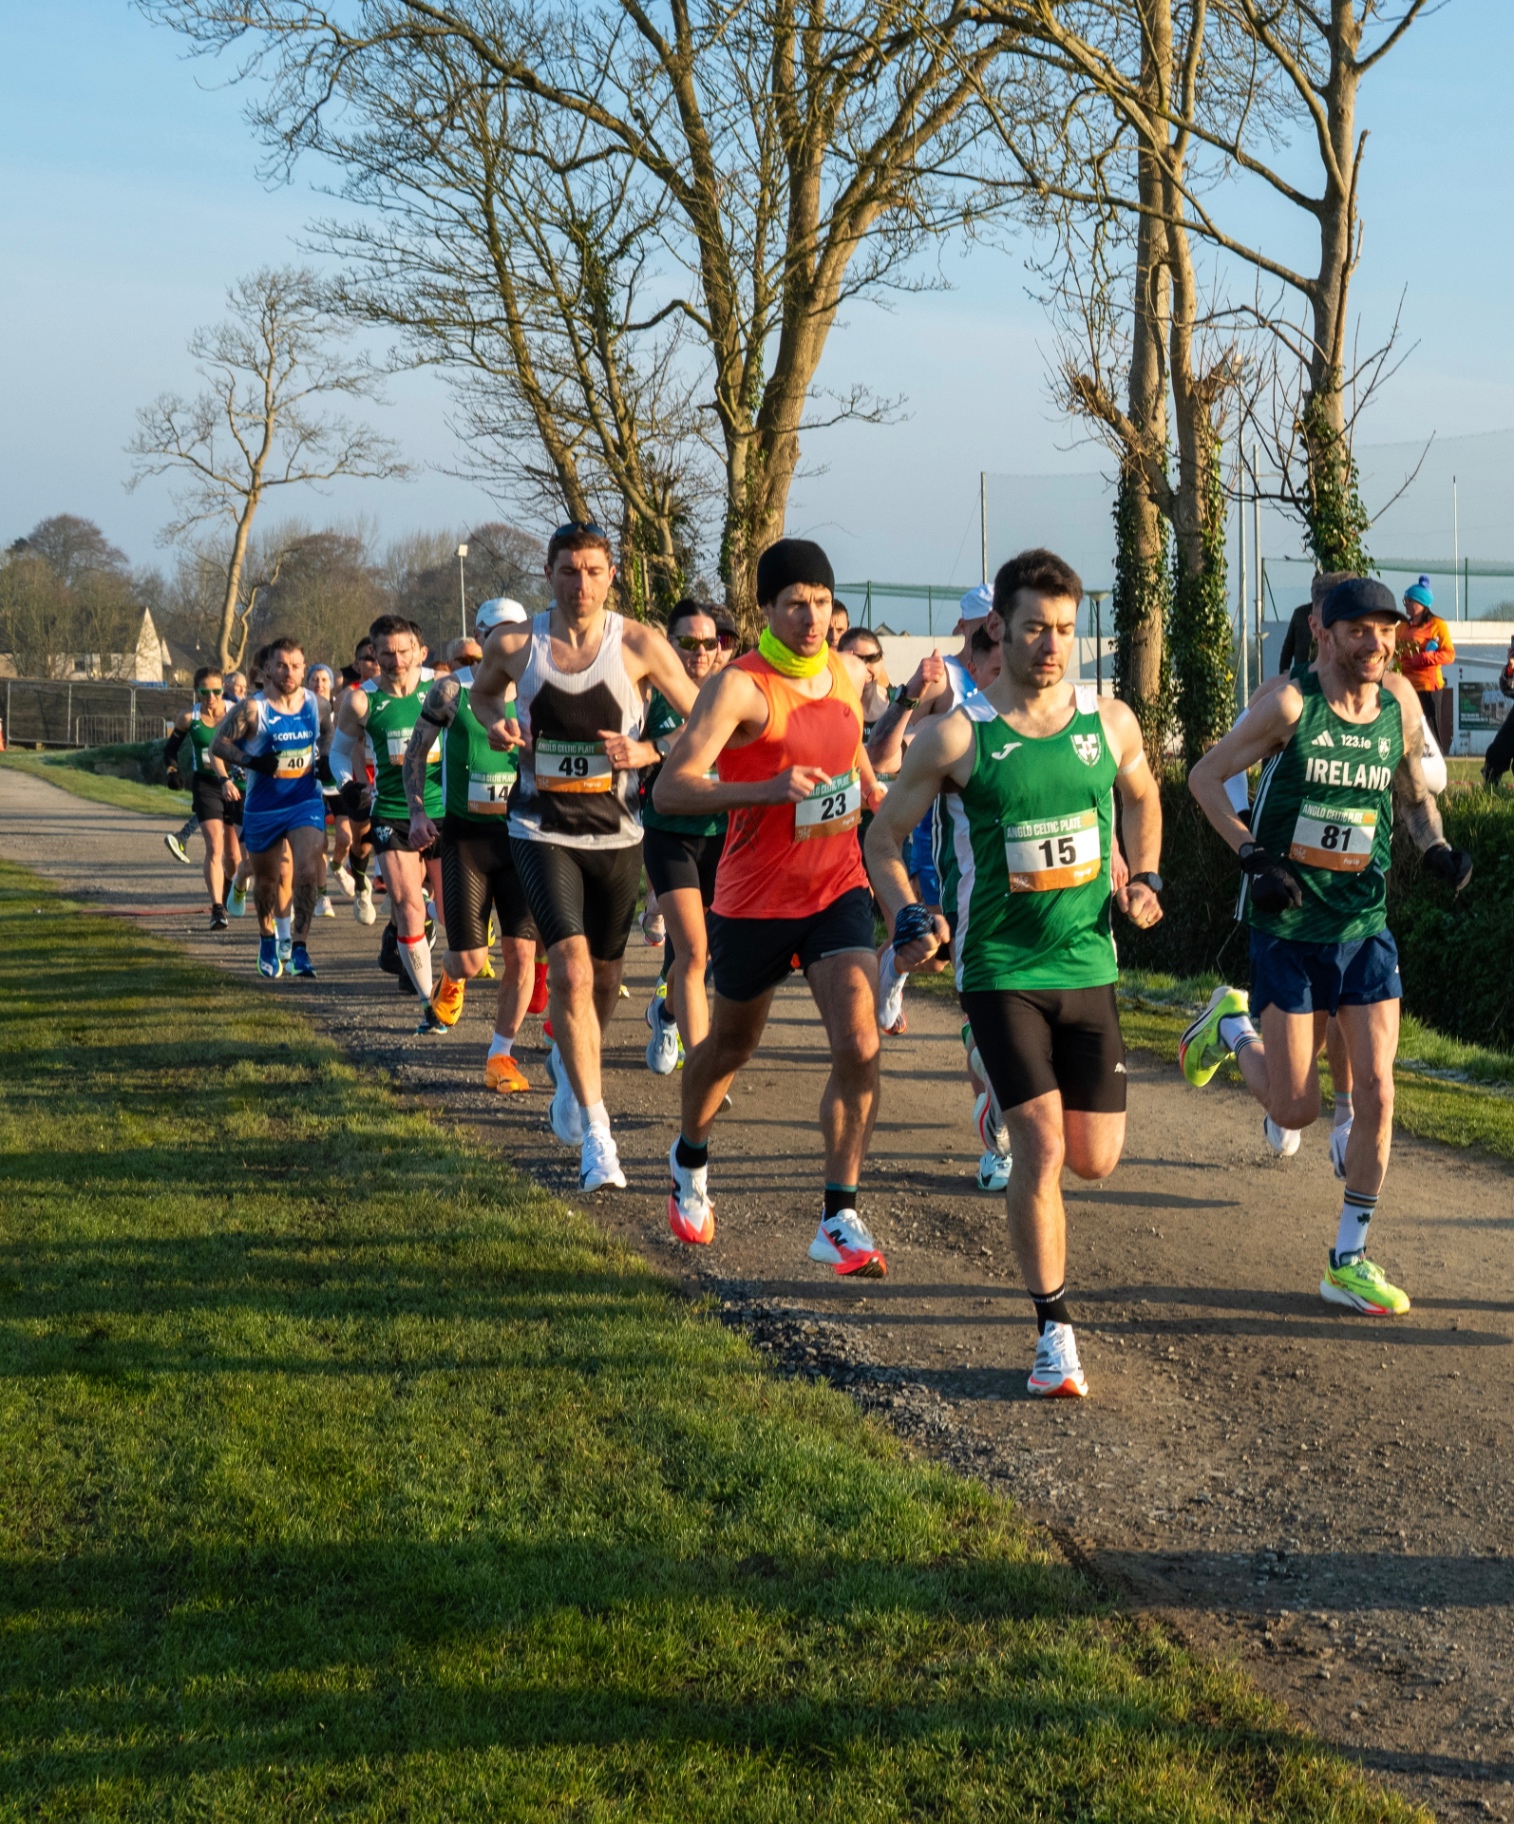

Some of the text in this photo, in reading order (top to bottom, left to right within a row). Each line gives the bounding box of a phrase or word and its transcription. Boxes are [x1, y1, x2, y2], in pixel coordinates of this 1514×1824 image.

[272, 730, 314, 742] SCOTLAND
[1340, 733, 1373, 750] 123.ie
[538, 742, 595, 754] ANGLO CELTIC PLATE
[287, 757, 304, 769] 40
[558, 756, 589, 777] 49
[1305, 757, 1392, 792] IRELAND
[487, 785, 509, 802] 14
[821, 792, 846, 821] 23
[1303, 803, 1364, 824] ANGLO CELTIC PLATE
[1006, 815, 1082, 839] ANGLO CELTIC PLATE
[1320, 825, 1353, 852] 81
[1038, 836, 1077, 868] 15
